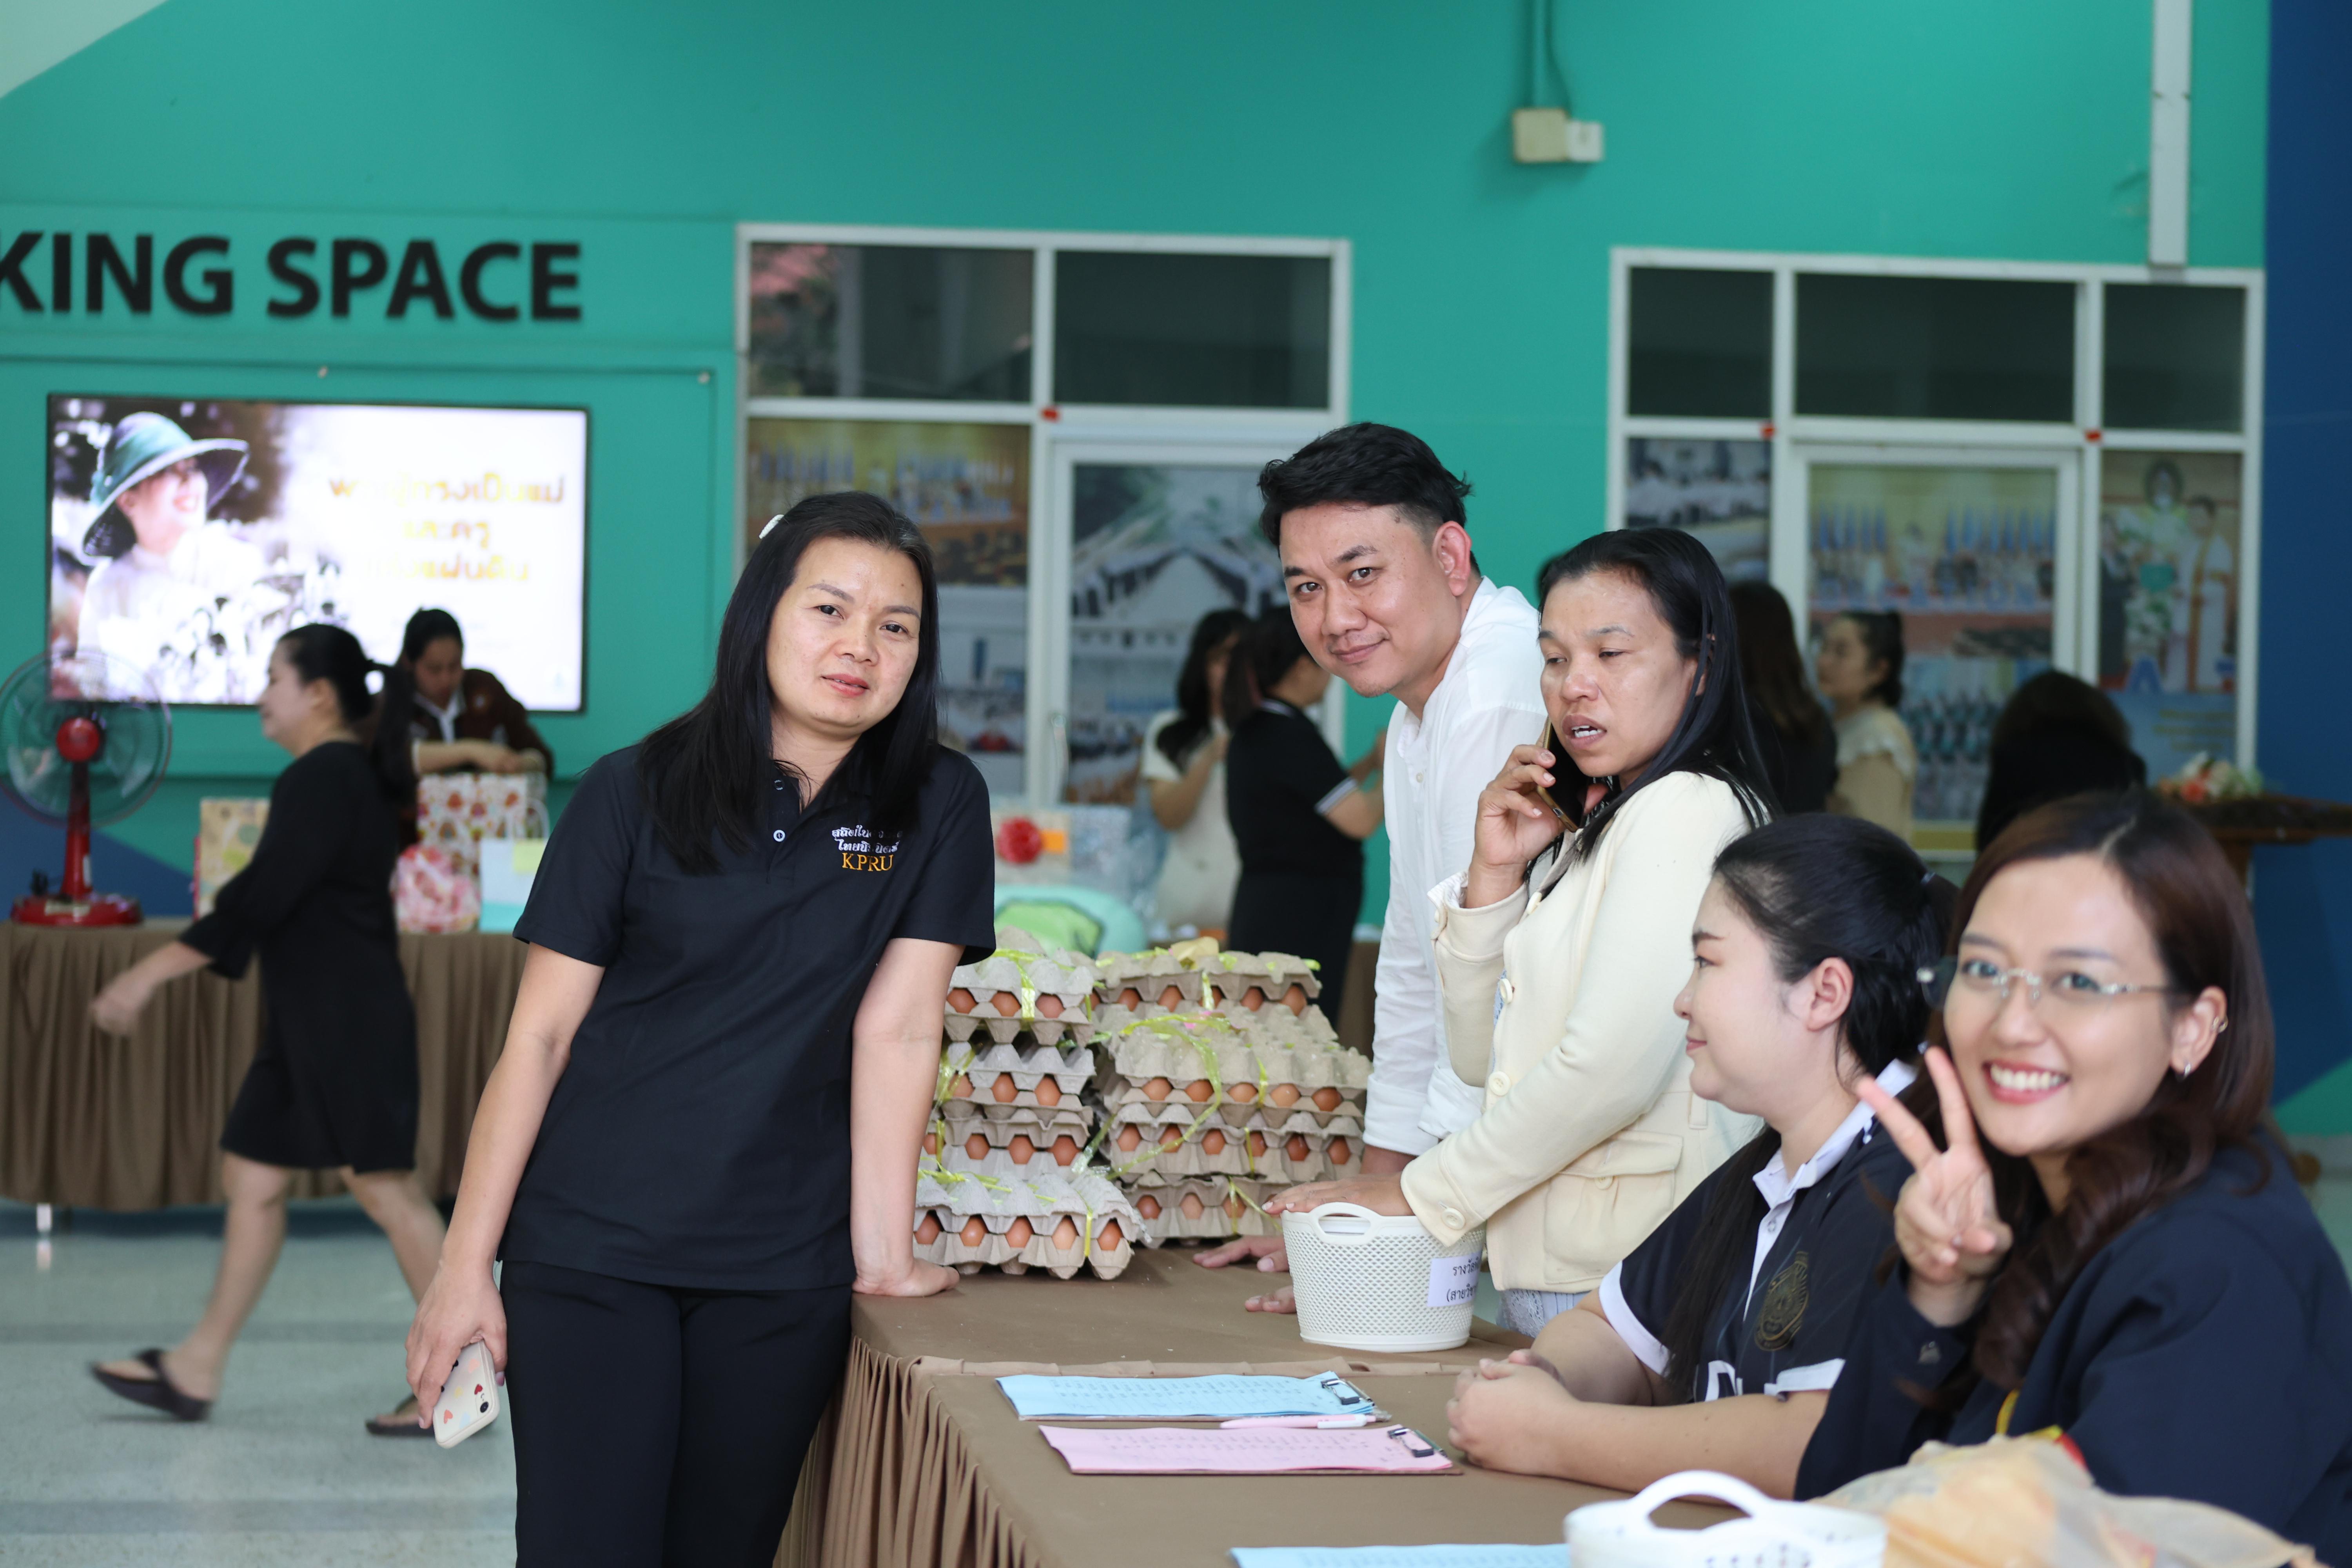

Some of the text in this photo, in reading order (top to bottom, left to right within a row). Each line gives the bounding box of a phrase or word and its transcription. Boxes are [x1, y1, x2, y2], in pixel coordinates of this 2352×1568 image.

[0, 231, 583, 322] KING SPACE
[842, 852, 894, 871] KPRU
